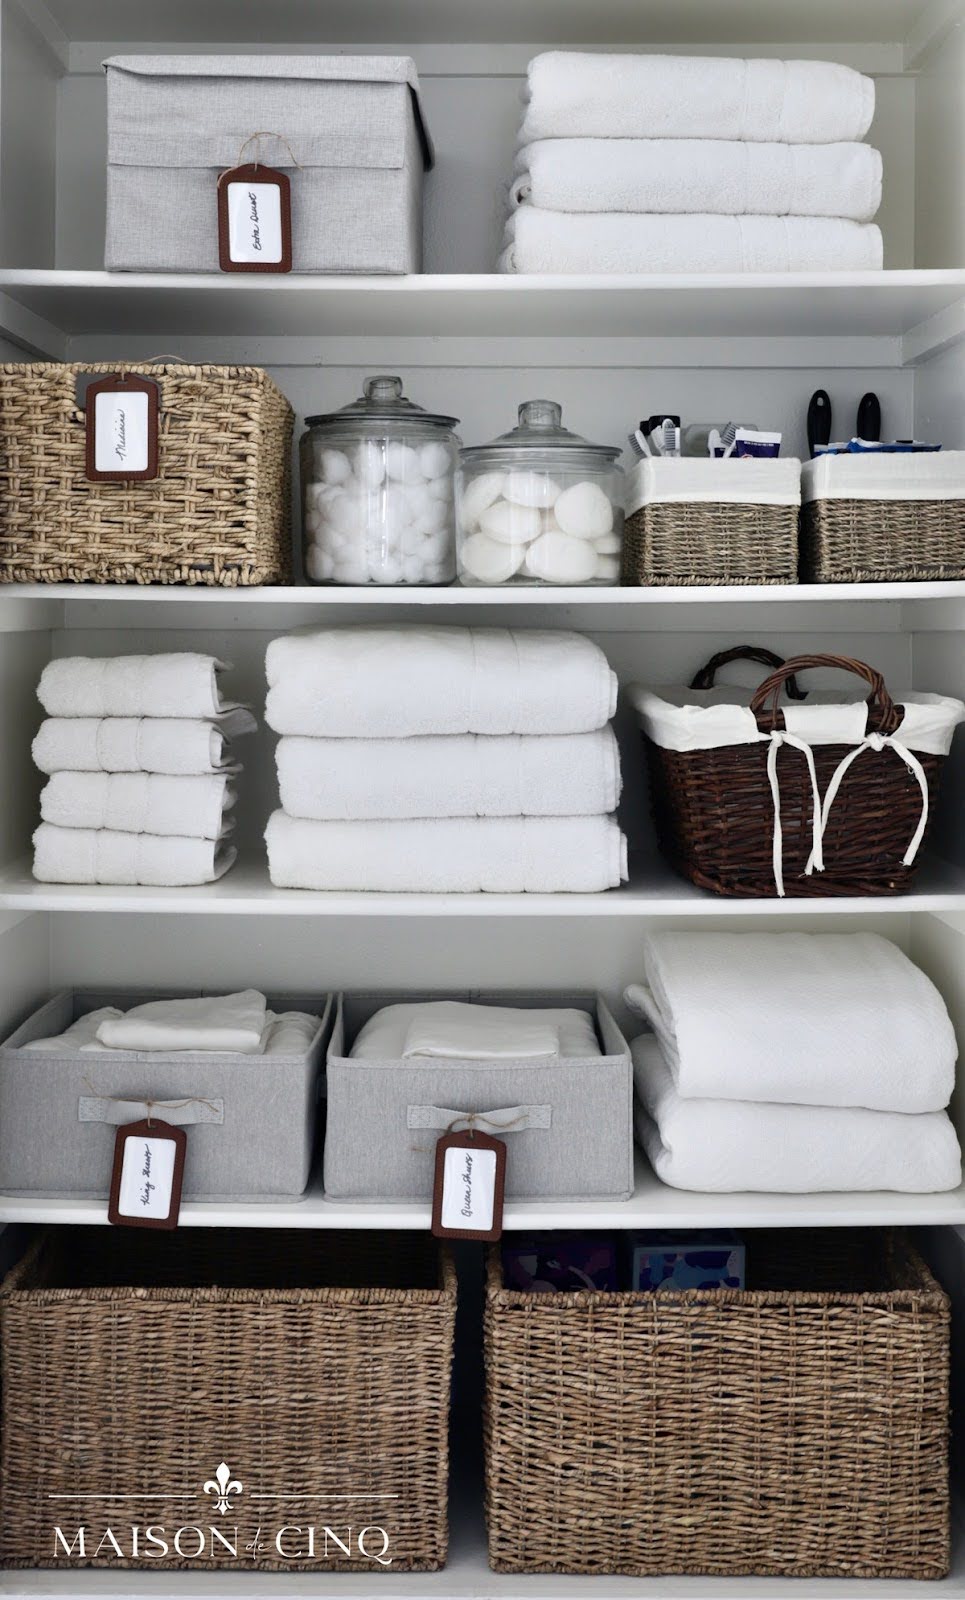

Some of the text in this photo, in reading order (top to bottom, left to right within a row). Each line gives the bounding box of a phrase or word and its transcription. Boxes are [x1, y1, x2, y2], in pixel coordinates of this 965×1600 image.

[251, 224, 262, 251] Extra
[114, 408, 127, 461] Medicine
[140, 1143, 155, 1206] King Sheets
[460, 1153, 473, 1218] Queen Sheets
